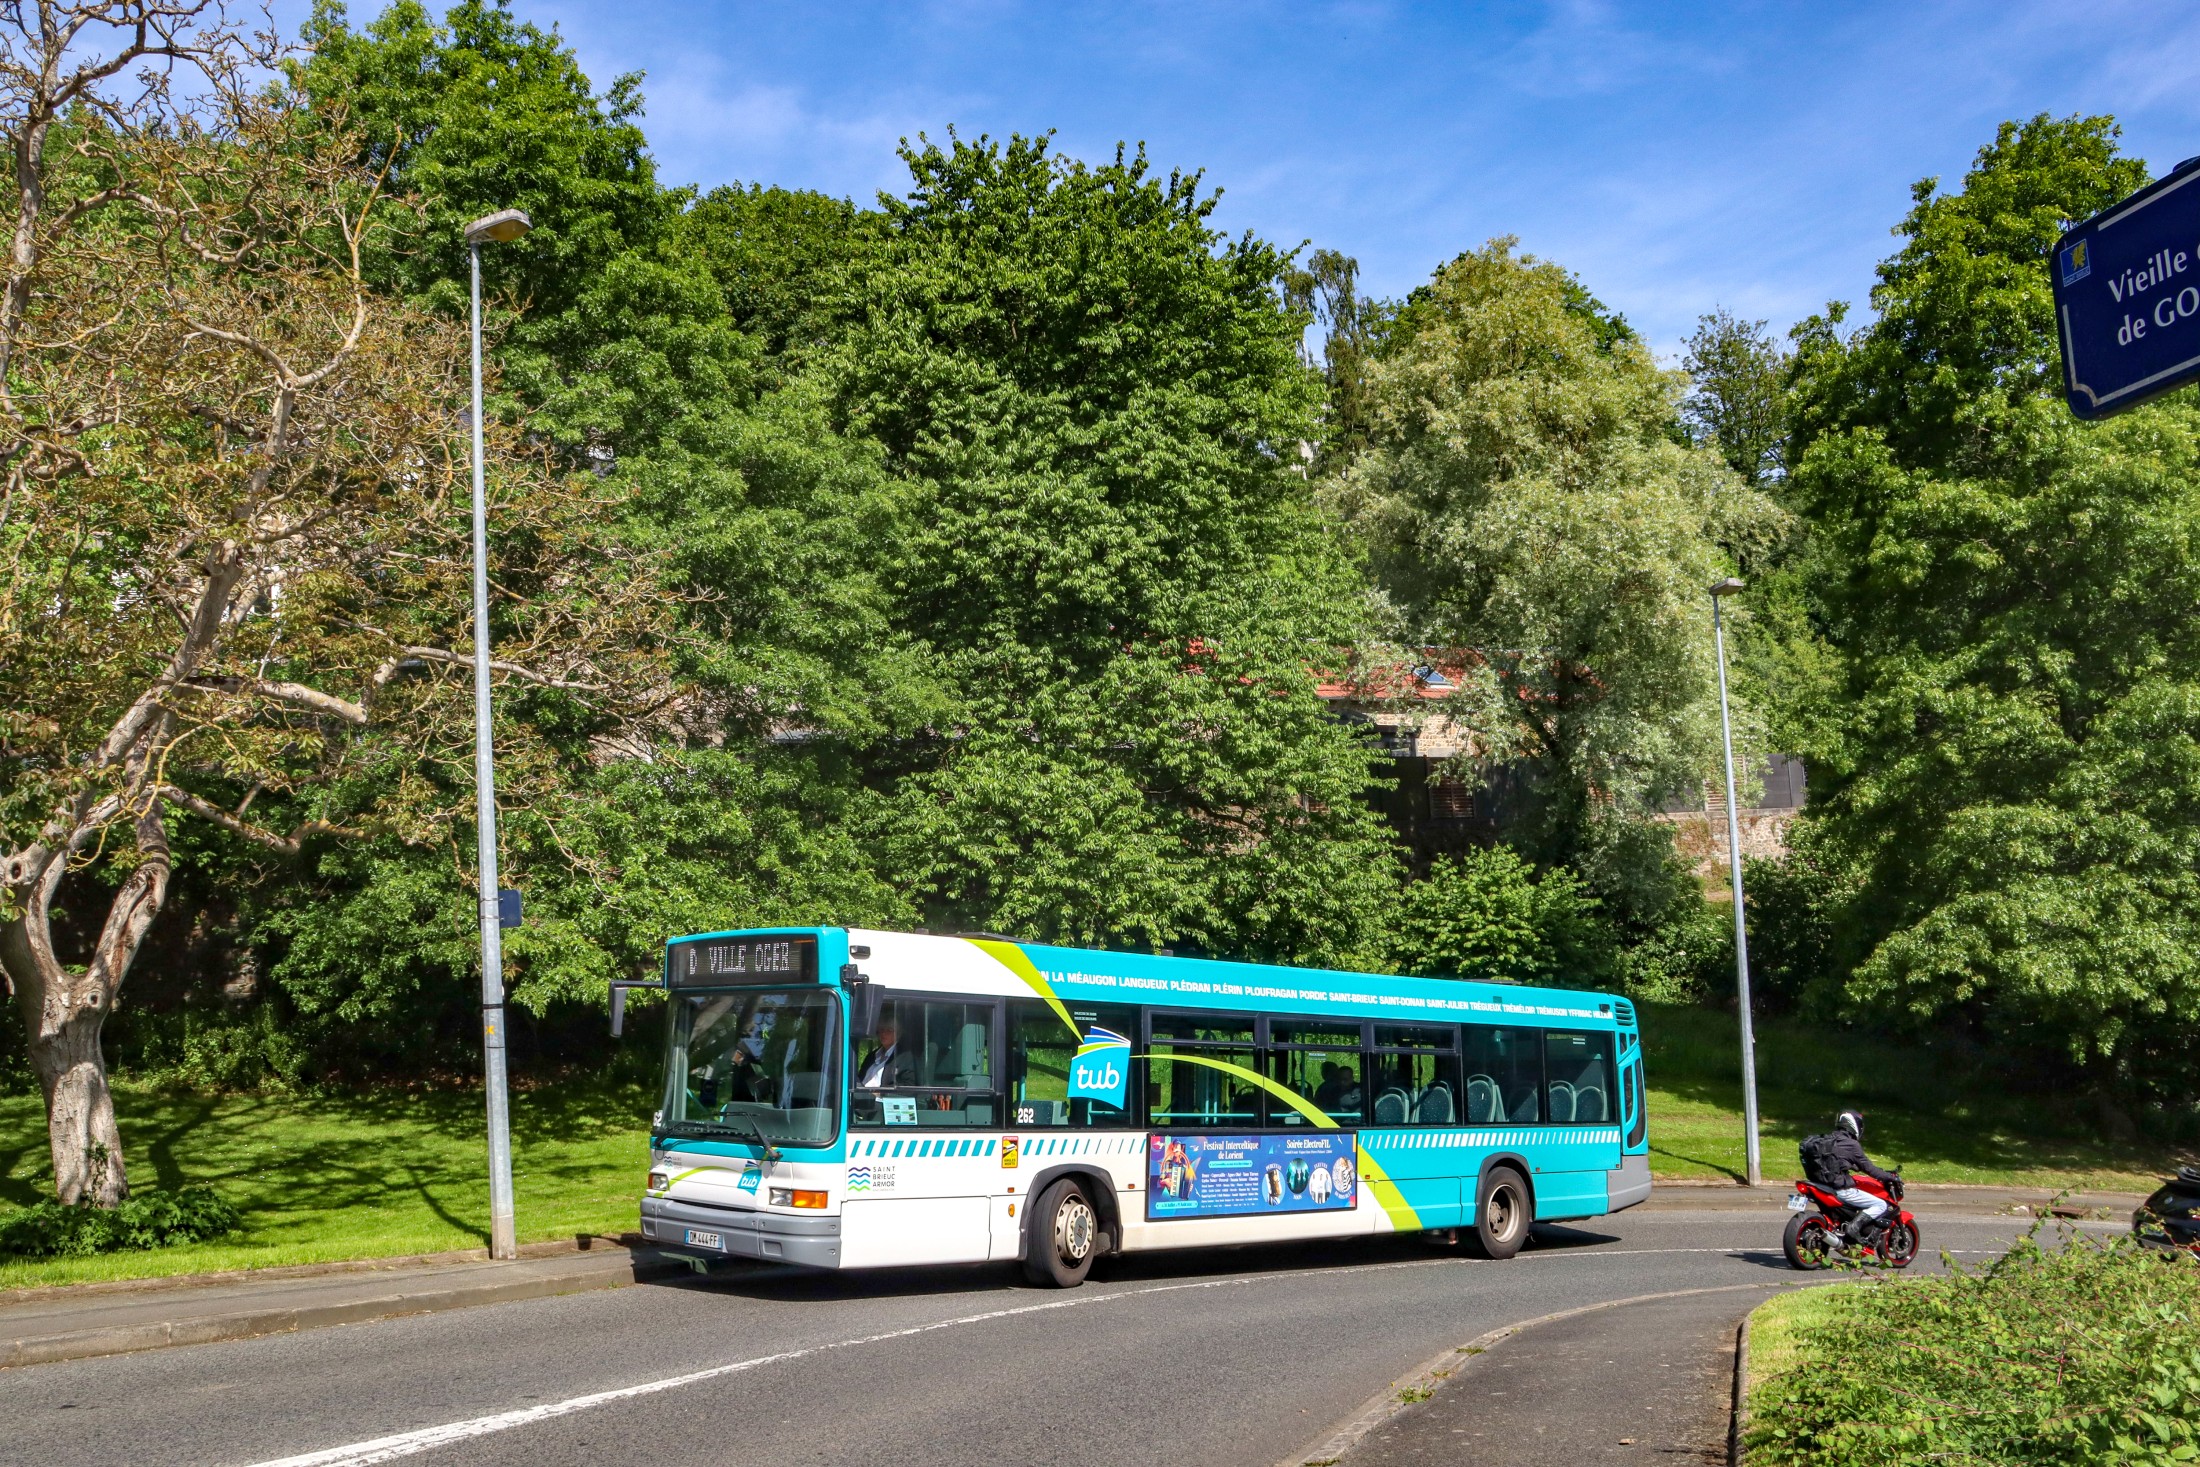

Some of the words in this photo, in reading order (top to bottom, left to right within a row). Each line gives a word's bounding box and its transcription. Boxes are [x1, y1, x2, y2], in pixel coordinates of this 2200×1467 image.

[2108, 248, 2187, 303] Vieille
[2117, 314, 2147, 346] de
[2154, 286, 2200, 327] GO
[689, 948, 698, 975] D
[708, 944, 747, 974] VILLE
[755, 942, 790, 972] OGER
[1052, 971, 1065, 982] LA
[1067, 971, 1117, 987] MÉAUGON
[1119, 976, 1168, 991] LANGUEUX
[1170, 979, 1211, 993] PLÉDRAN
[1213, 982, 1243, 995] PLÉRIN
[1245, 985, 1298, 999] PLOUFRAGAN
[1299, 989, 1328, 1001] PORDIC
[1329, 991, 1378, 1005] SAINT-BRIEUC
[1379, 995, 1425, 1007] SAINT-DONAN
[1426, 998, 1469, 1010] SAINT-JULIEN
[1469, 1001, 1501, 1012] TRÉGUEUX
[1502, 1003, 1535, 1014] TRÉMÉLOIR
[1076, 1061, 1120, 1089] tub
[1018, 1107, 1034, 1123] 262
[1203, 1140, 1225, 1150] Festival
[1225, 1140, 1259, 1151] Interceltique
[1286, 1139, 1303, 1148] Soirée
[1218, 1151, 1225, 1159] de
[1225, 1151, 1244, 1159] Lorient
[740, 1175, 758, 1187] tub
